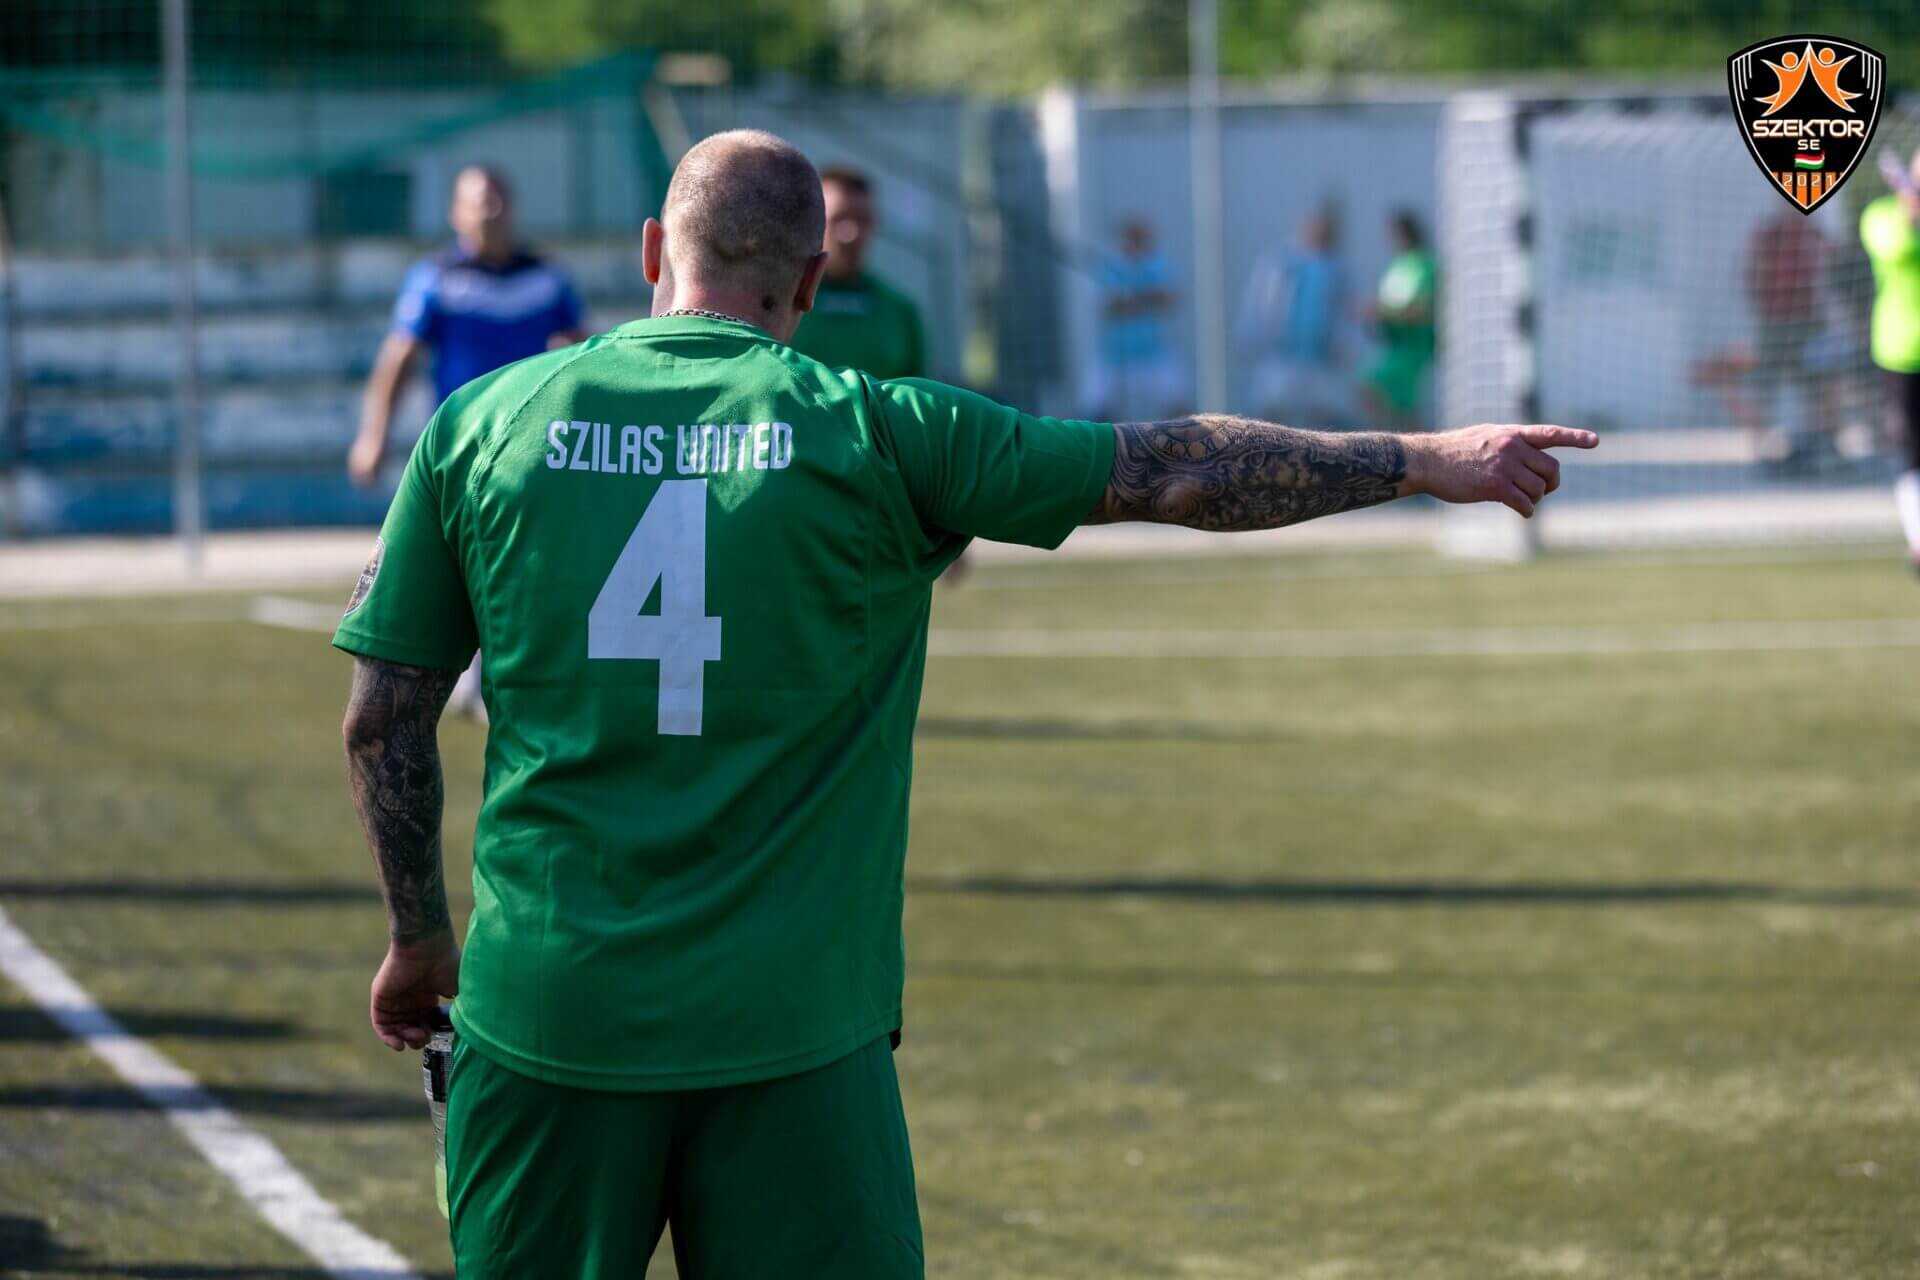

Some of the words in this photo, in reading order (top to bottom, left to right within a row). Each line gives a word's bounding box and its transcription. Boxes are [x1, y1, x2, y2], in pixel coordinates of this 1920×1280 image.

[546, 420, 664, 475] SZILAS
[675, 422, 793, 475] UNITED
[587, 478, 722, 736] 4
